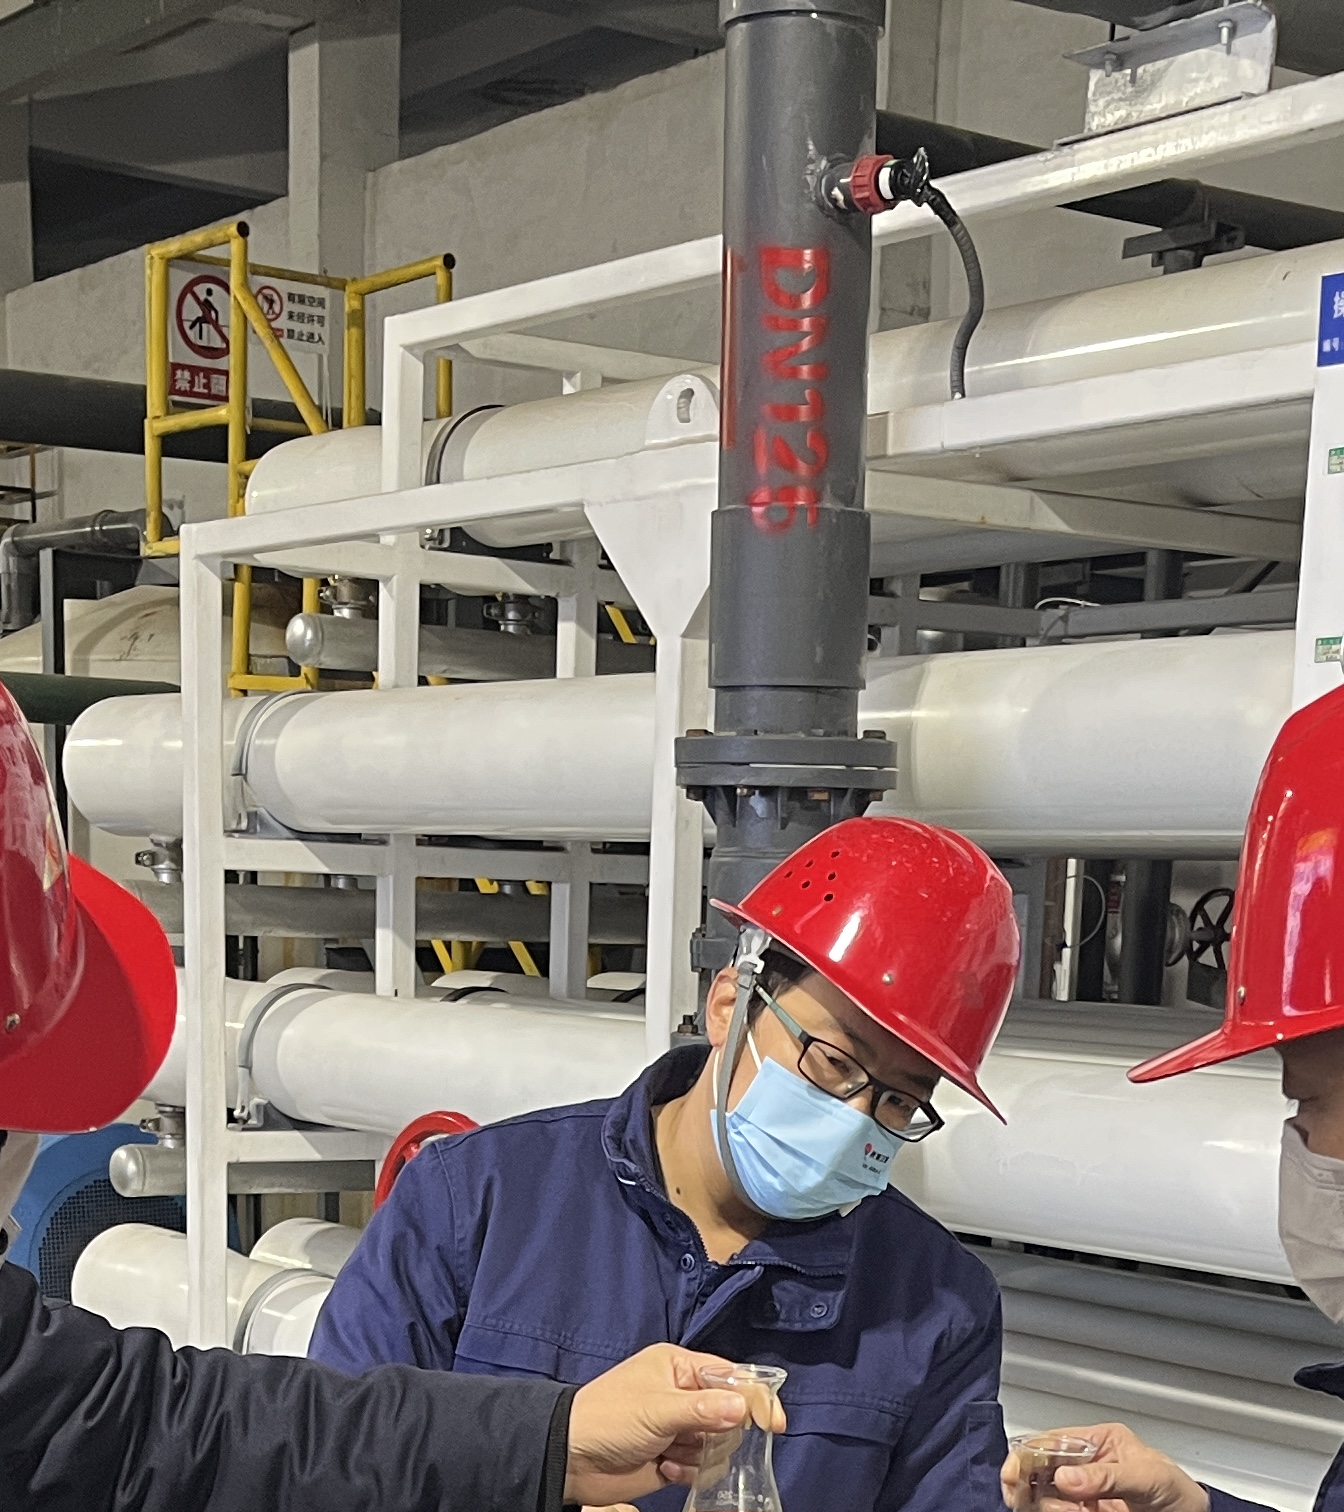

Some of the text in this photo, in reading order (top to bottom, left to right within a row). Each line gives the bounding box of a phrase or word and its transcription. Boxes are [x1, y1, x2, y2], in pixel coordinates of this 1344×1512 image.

[287, 310, 326, 328] 未经许可
[287, 328, 326, 346] 禁止进入
